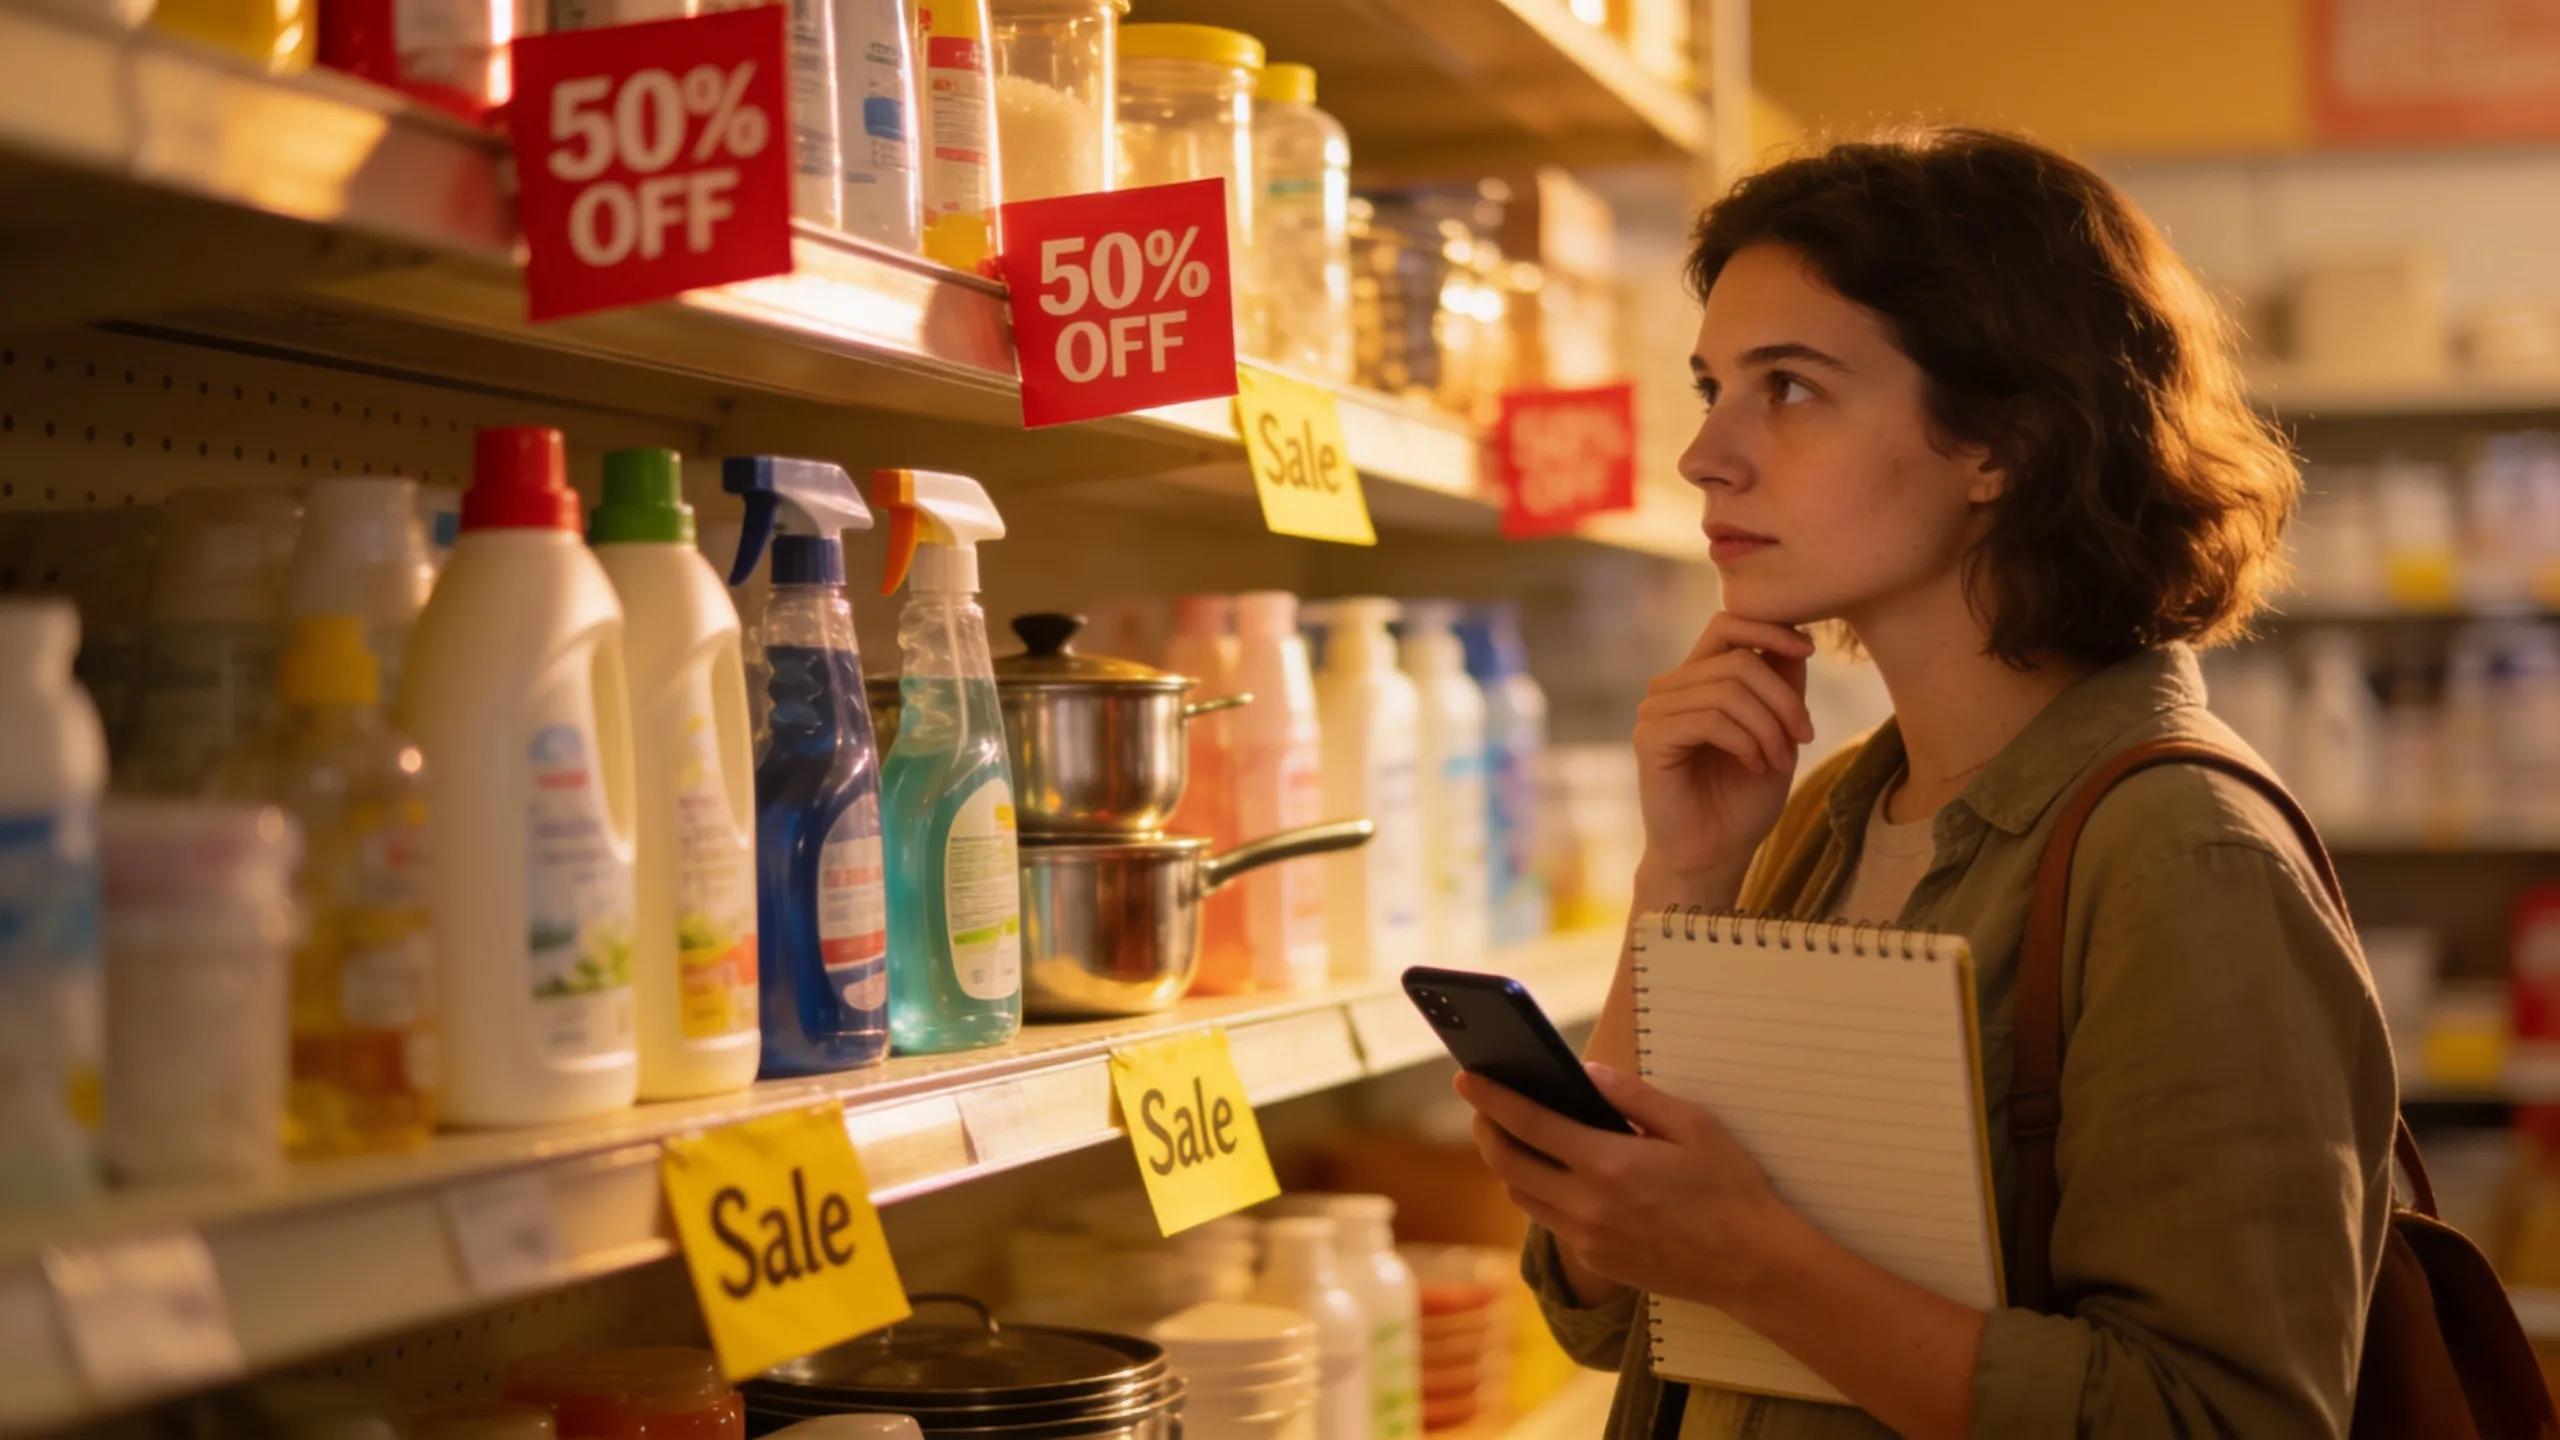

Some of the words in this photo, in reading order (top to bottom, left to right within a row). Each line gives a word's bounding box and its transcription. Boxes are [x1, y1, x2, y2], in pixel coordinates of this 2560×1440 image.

[550, 63, 767, 180] 50%
[571, 172, 738, 265] OFF
[1040, 226, 1210, 316] 50%
[1056, 310, 1188, 383] OFF
[1258, 411, 1341, 493] Sale
[1141, 1077, 1237, 1176] Sale
[709, 1168, 855, 1300] Sale
